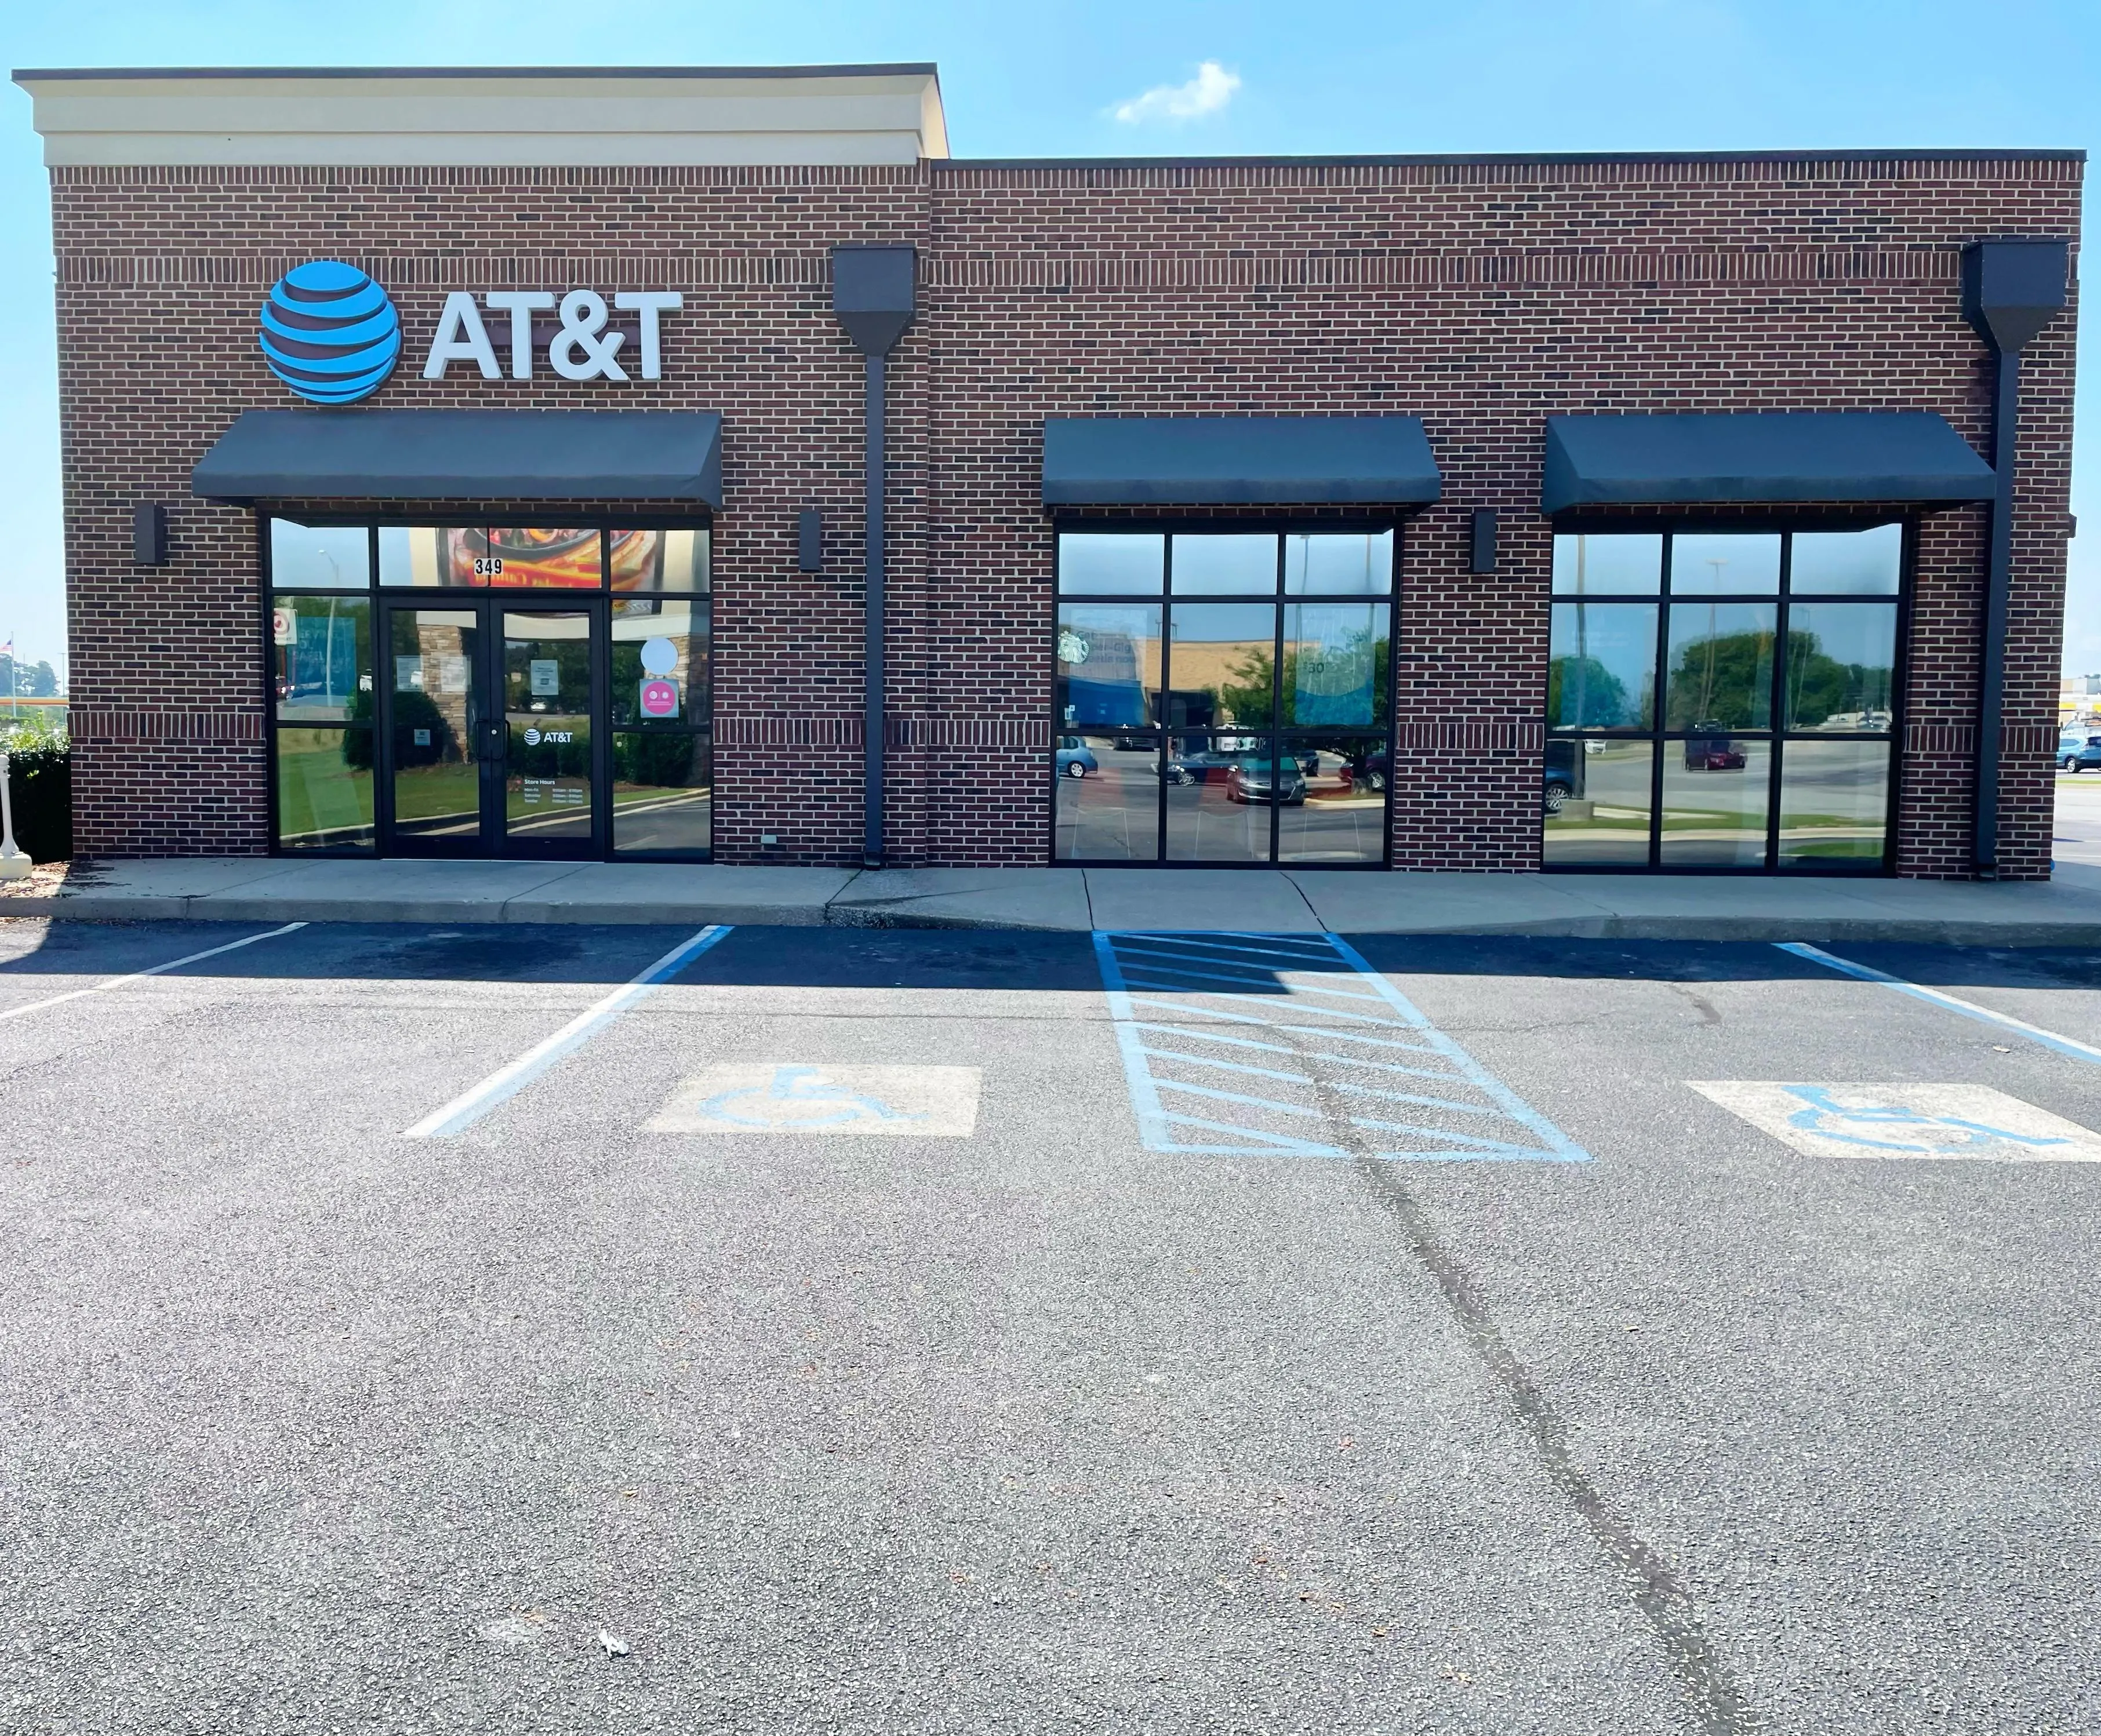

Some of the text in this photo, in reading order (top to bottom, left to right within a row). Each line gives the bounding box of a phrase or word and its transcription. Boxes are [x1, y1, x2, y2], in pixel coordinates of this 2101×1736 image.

[423, 289, 682, 381] AT&T
[475, 559, 502, 574] 349
[544, 732, 573, 743] AT&T
